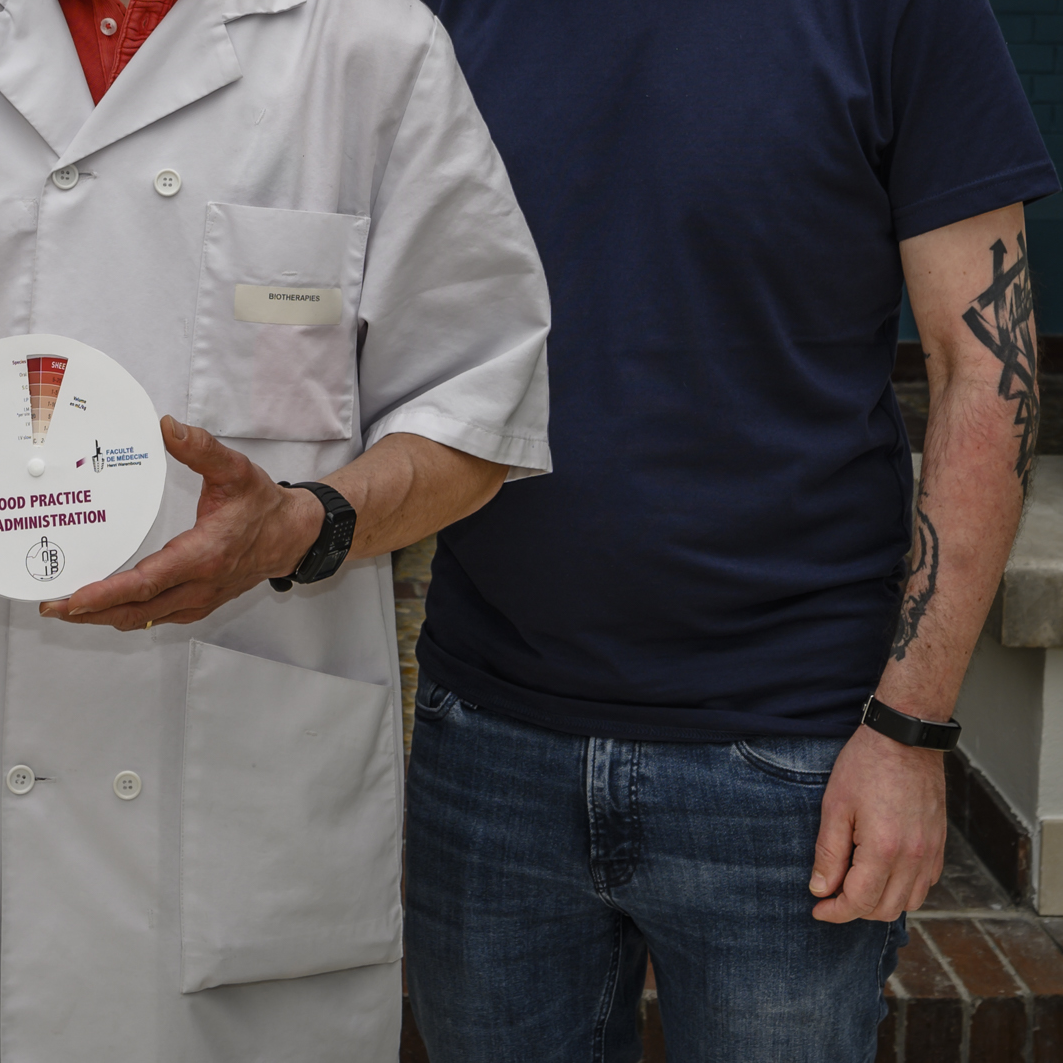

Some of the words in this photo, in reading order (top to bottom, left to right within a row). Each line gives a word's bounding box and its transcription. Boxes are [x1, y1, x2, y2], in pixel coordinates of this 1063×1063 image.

[268, 293, 321, 302] BIOTHERAPIES
[73, 396, 87, 404] Volume
[106, 446, 134, 455] FACULTÉ
[116, 452, 149, 461] MÉDECINE
[30, 490, 91, 508] PRACTICE
